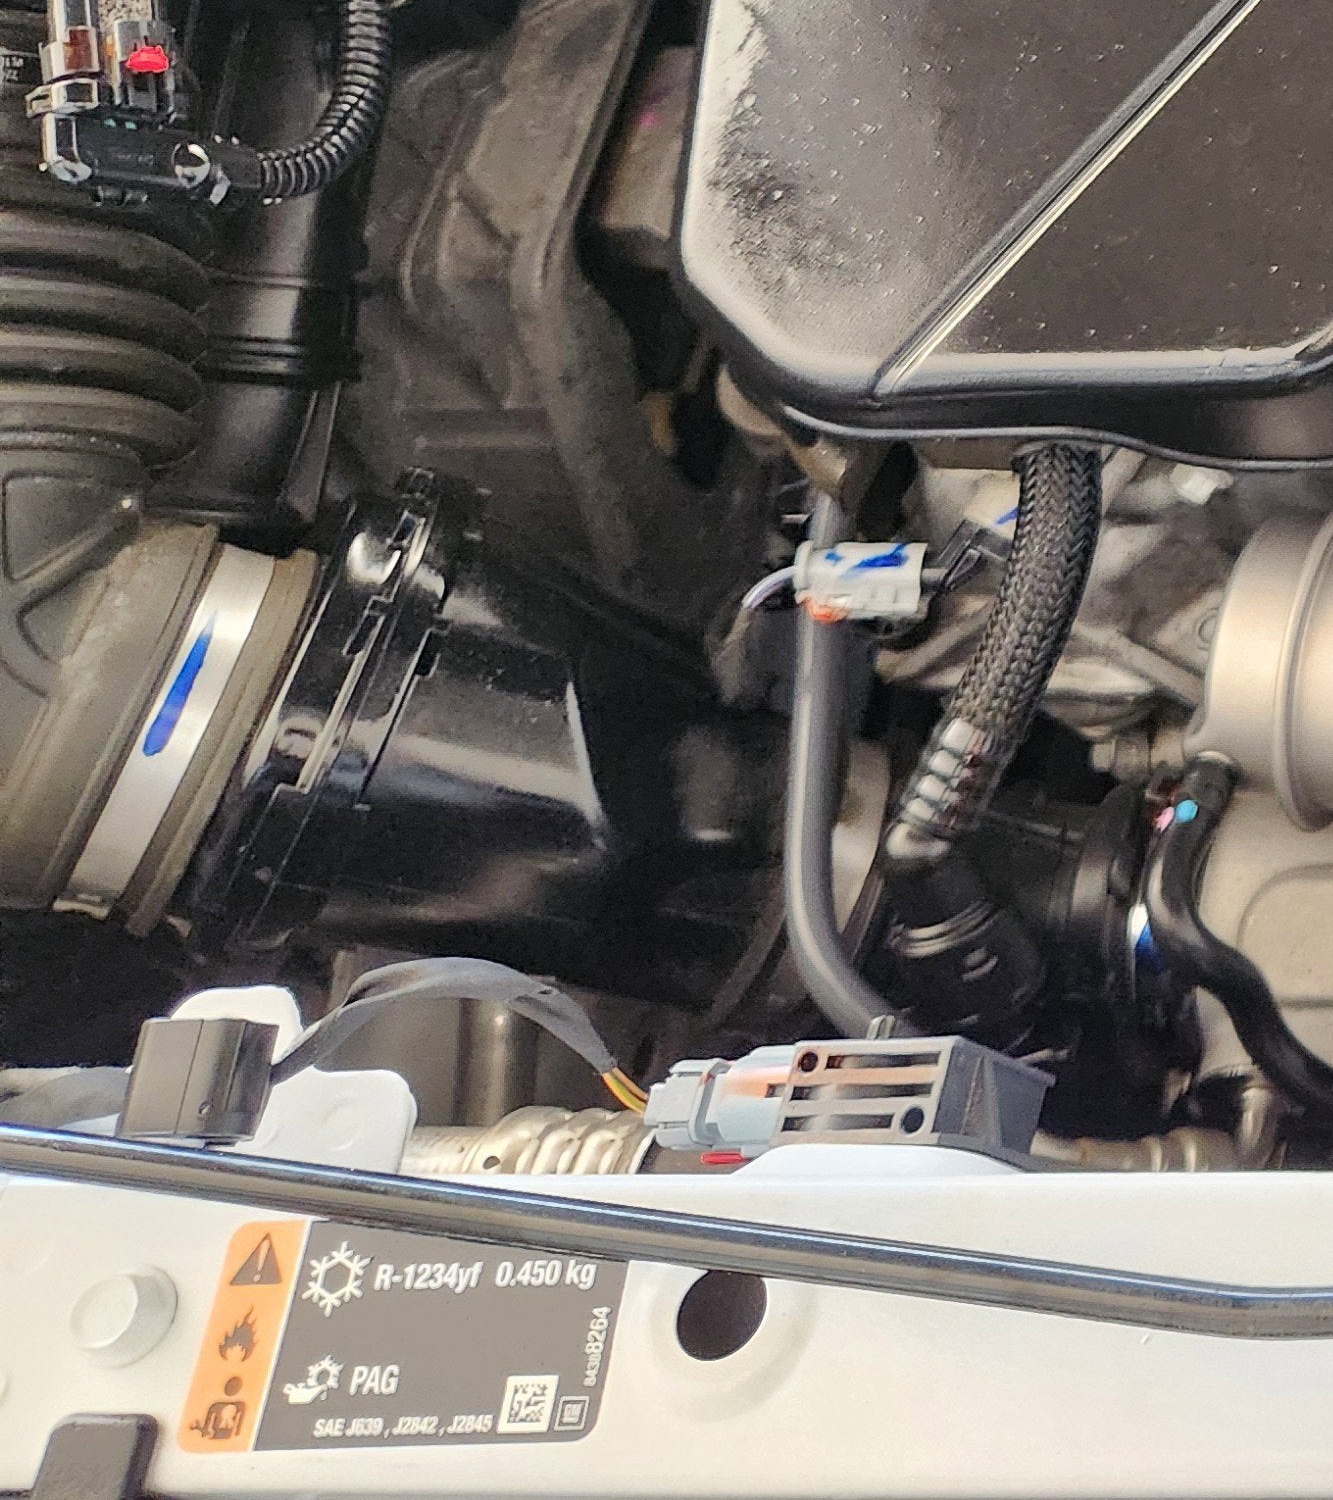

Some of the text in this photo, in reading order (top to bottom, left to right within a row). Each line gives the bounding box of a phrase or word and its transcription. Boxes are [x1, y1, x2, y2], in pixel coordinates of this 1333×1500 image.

[374, 1259, 598, 1293] R-1234yf 0.450 kg
[349, 1365, 400, 1395] PAG
[313, 1418, 346, 1438] SAE
[447, 1414, 493, 1433] J2845
